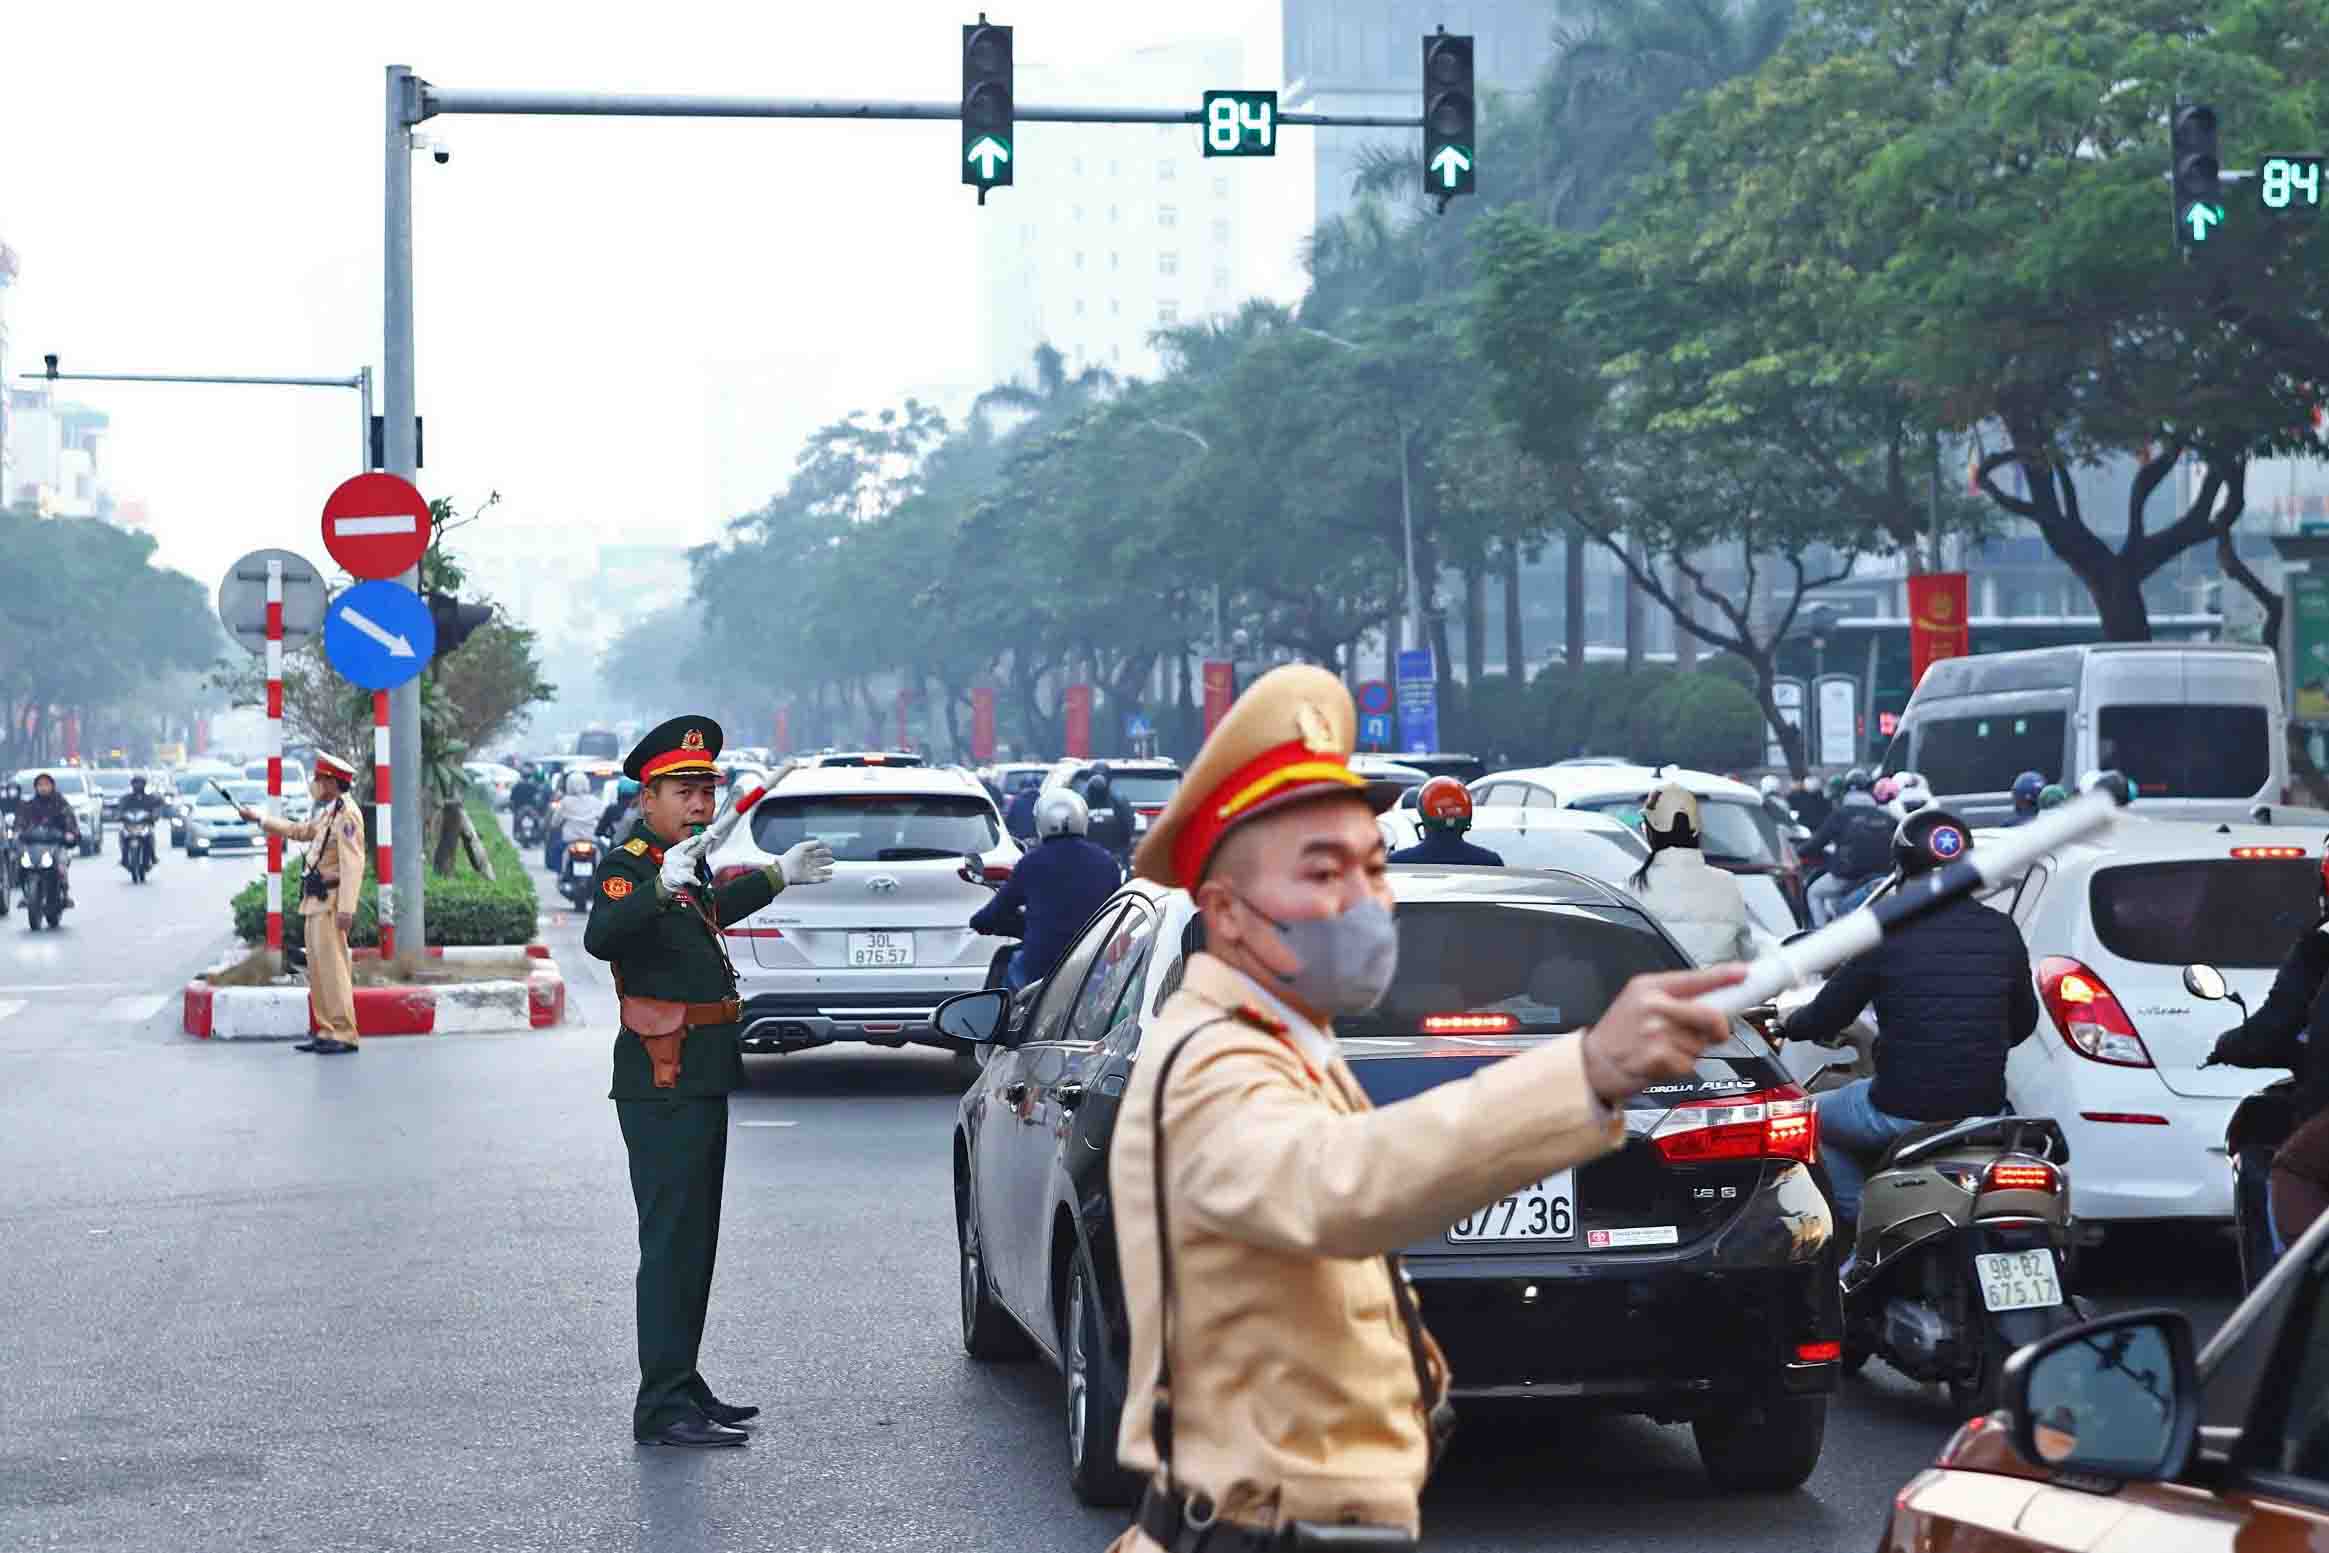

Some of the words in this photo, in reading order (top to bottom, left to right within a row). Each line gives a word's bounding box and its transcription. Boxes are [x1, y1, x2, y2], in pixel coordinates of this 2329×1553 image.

[1208, 97, 1271, 150] 84
[2262, 159, 2319, 208] 84
[866, 934, 895, 948] 30L
